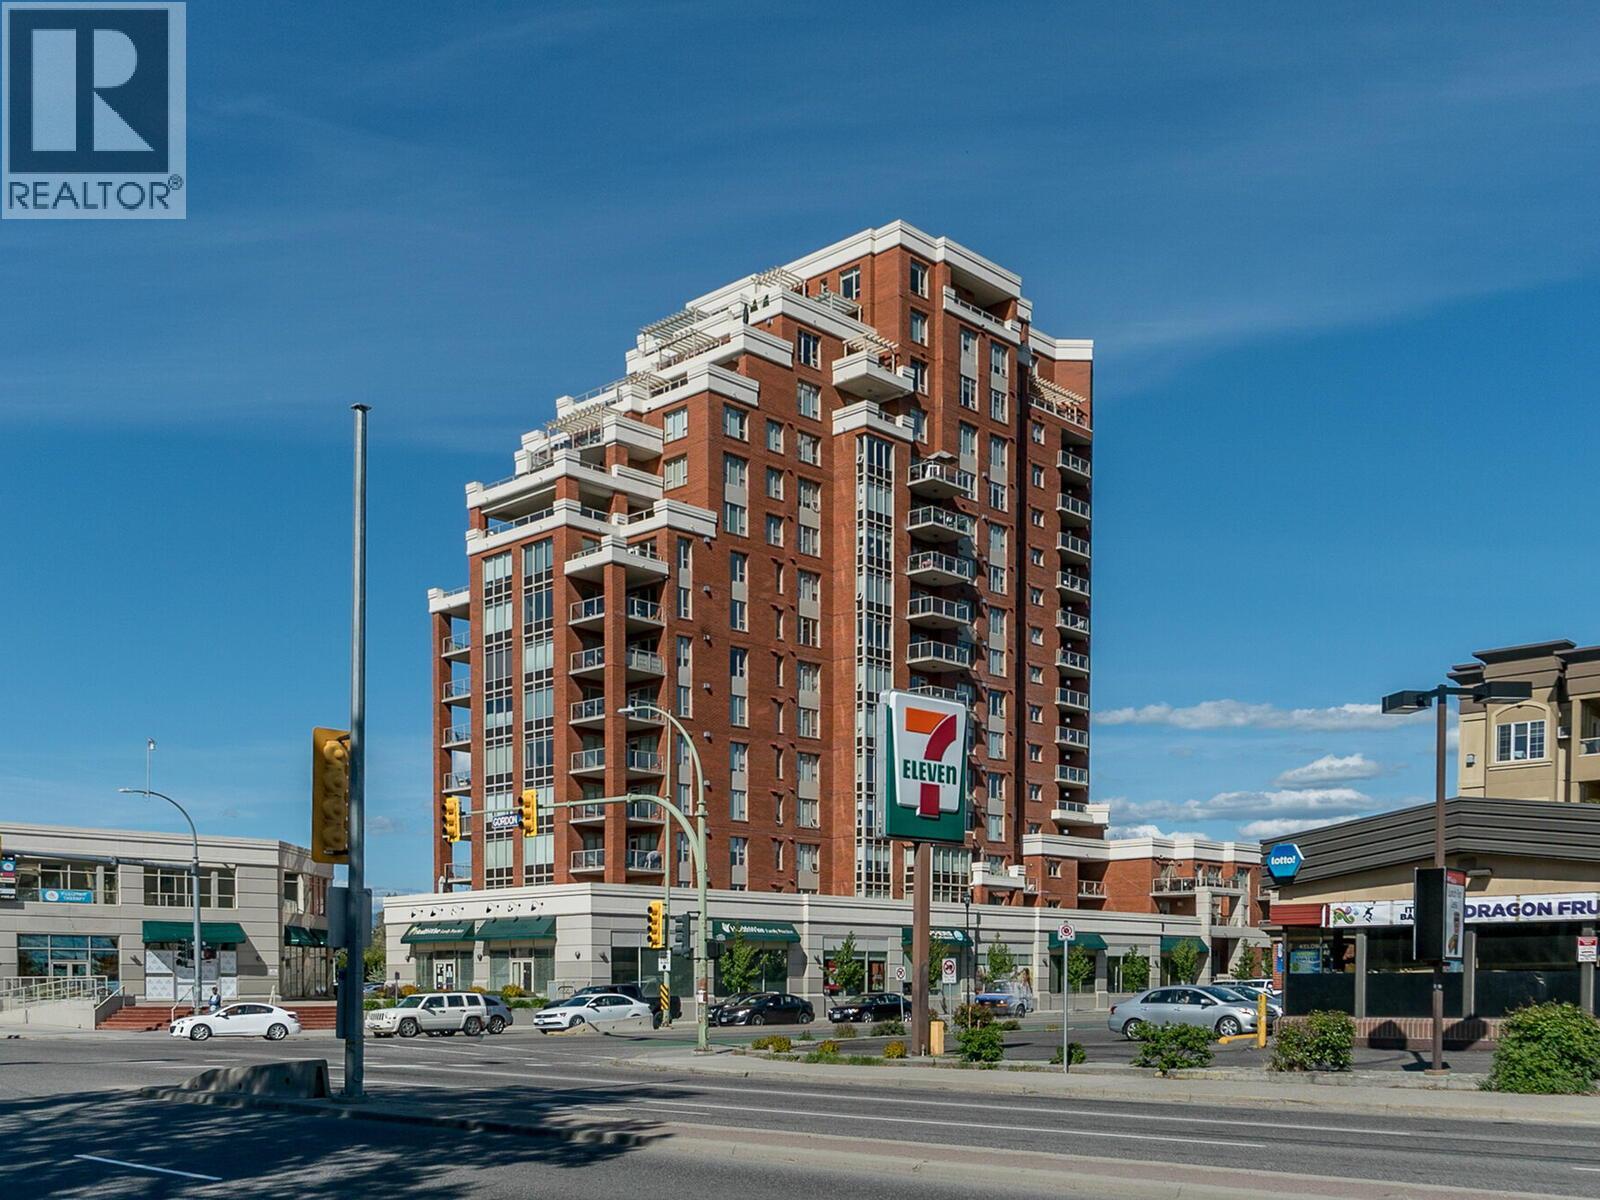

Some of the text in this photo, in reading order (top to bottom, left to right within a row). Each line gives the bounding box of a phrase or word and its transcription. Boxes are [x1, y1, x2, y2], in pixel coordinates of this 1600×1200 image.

[904, 706, 957, 817] 7
[493, 814, 518, 827] GORDON
[1464, 901, 1553, 919] DRAGON
